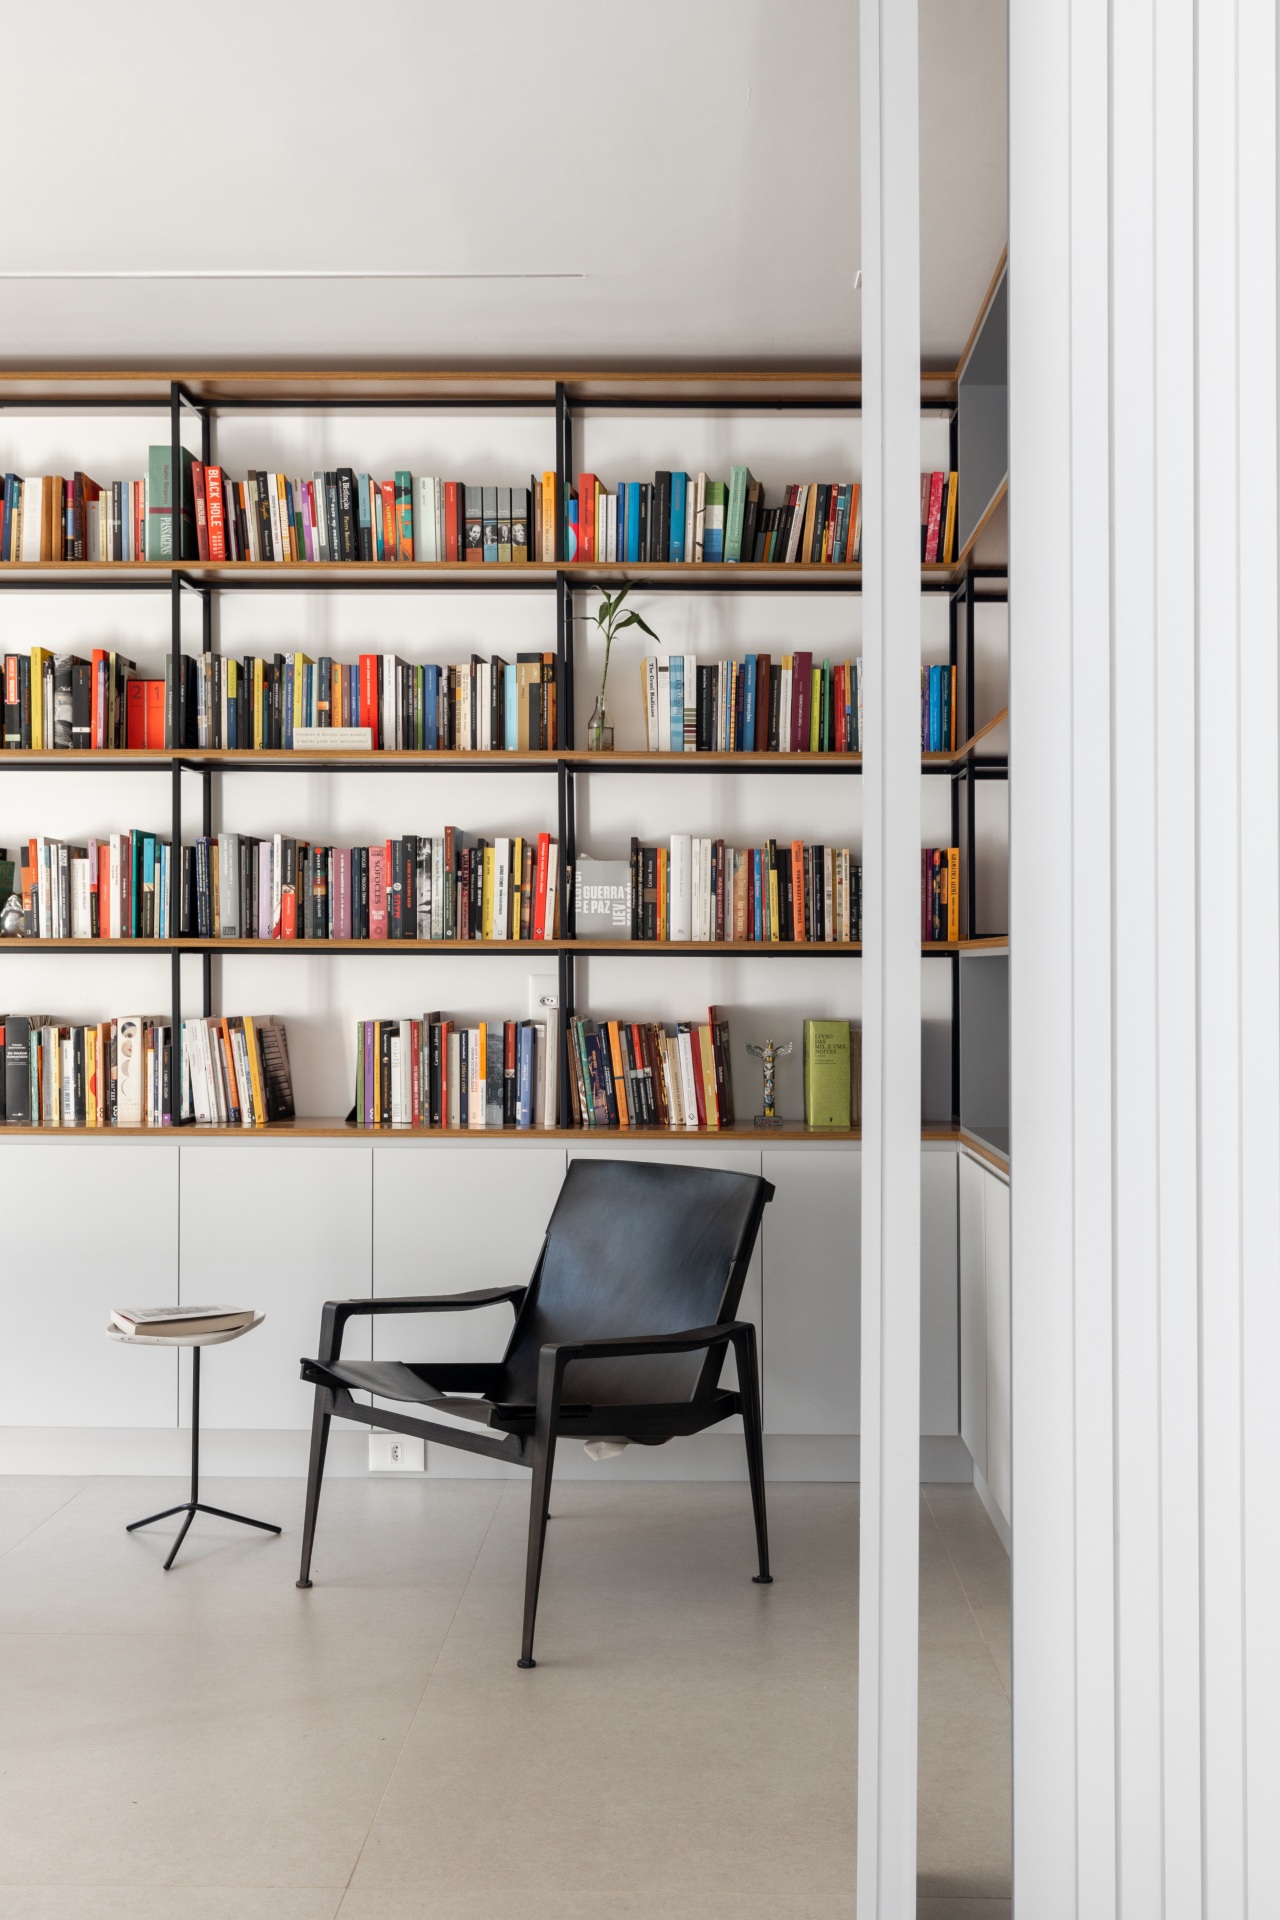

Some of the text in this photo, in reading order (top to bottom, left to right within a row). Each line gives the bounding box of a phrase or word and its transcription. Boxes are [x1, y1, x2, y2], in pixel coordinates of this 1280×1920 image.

[208, 470, 222, 527] BLACK HOLE
[160, 517, 172, 554] PASSAGENS
[132, 685, 142, 699] 2
[154, 687, 159, 700] 1
[374, 860, 382, 904] SÓFOCLES
[583, 886, 624, 899] GUERRA
[583, 901, 610, 913] E PAZ
[613, 904, 625, 925] LIEV
